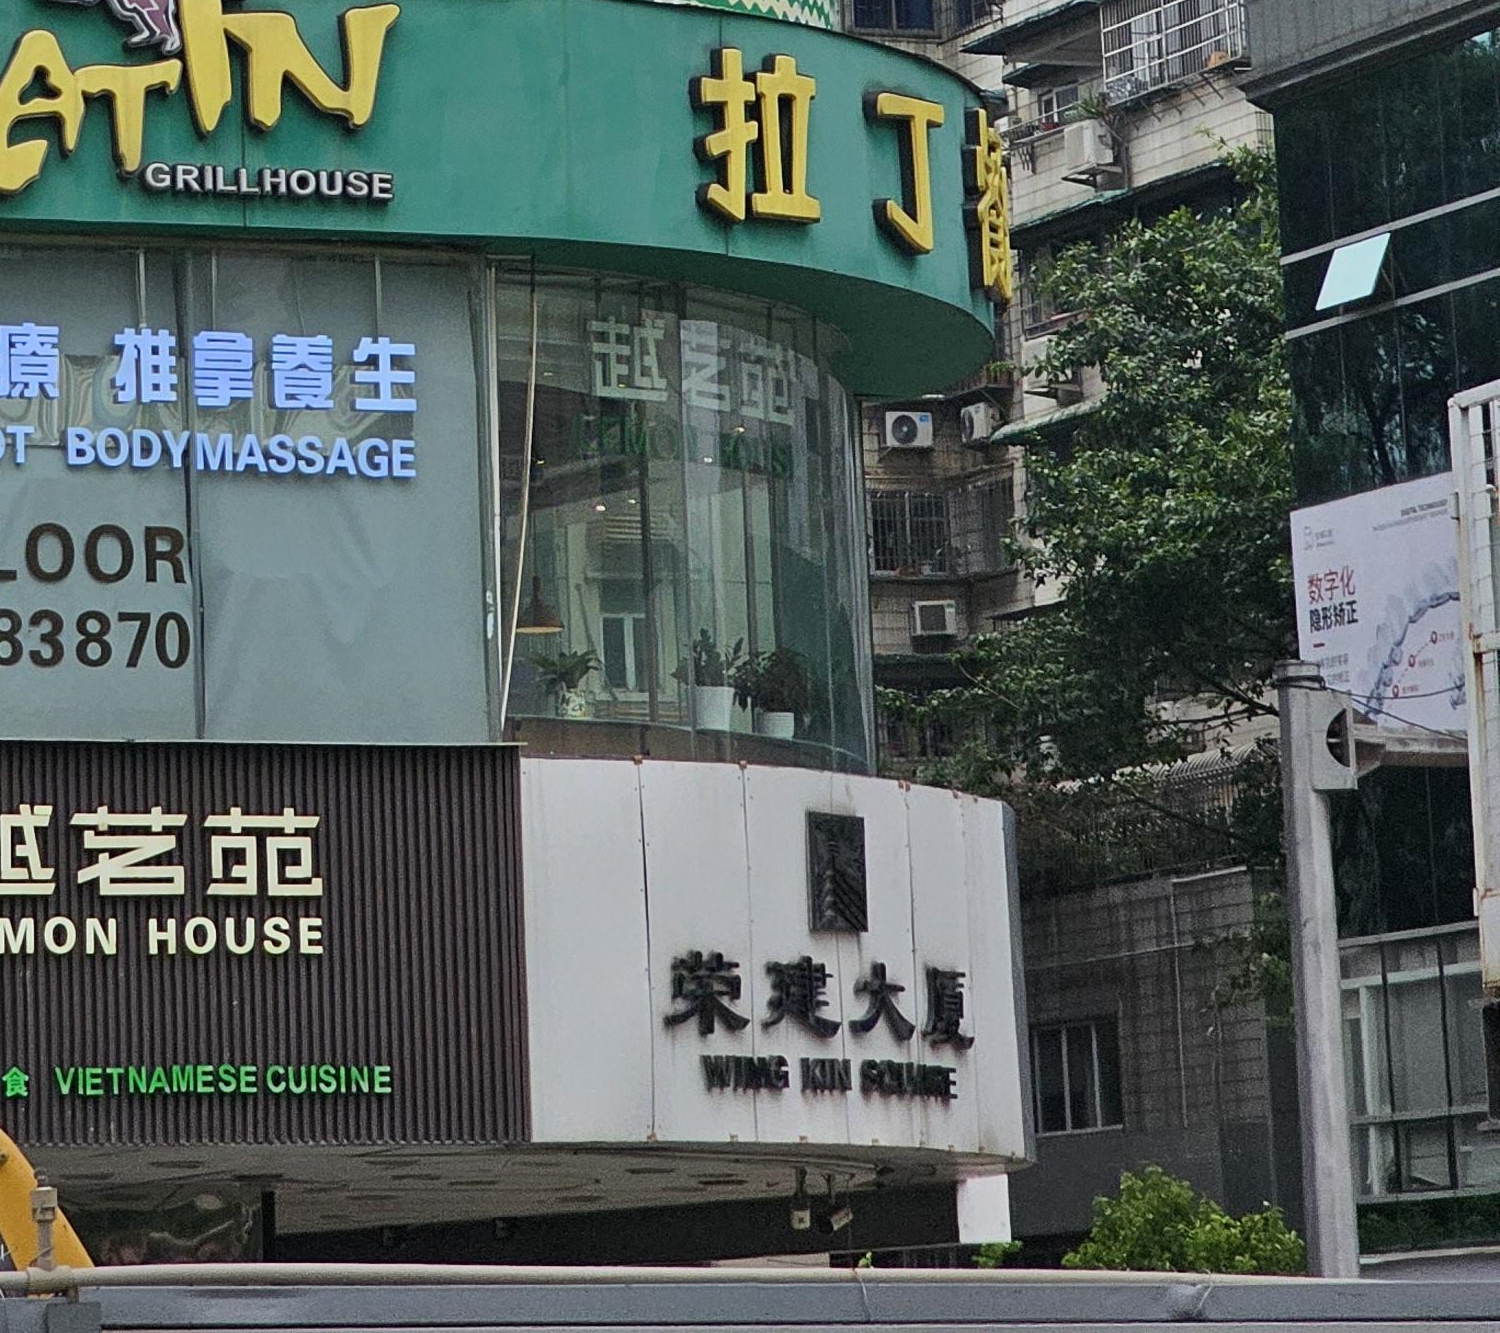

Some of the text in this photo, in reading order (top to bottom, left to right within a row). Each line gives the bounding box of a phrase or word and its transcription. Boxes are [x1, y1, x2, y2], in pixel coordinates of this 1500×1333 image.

[143, 162, 395, 205] GRILLHOUSE
[1307, 565, 1356, 604] 数字化
[1309, 600, 1359, 633] 隐形矫正
[148, 916, 325, 956] HOUSE
[54, 1064, 258, 1097] VIETNAMESE
[266, 1064, 392, 1095] CUISINE
[700, 1055, 790, 1090] WING
[799, 1057, 853, 1090] KIN
